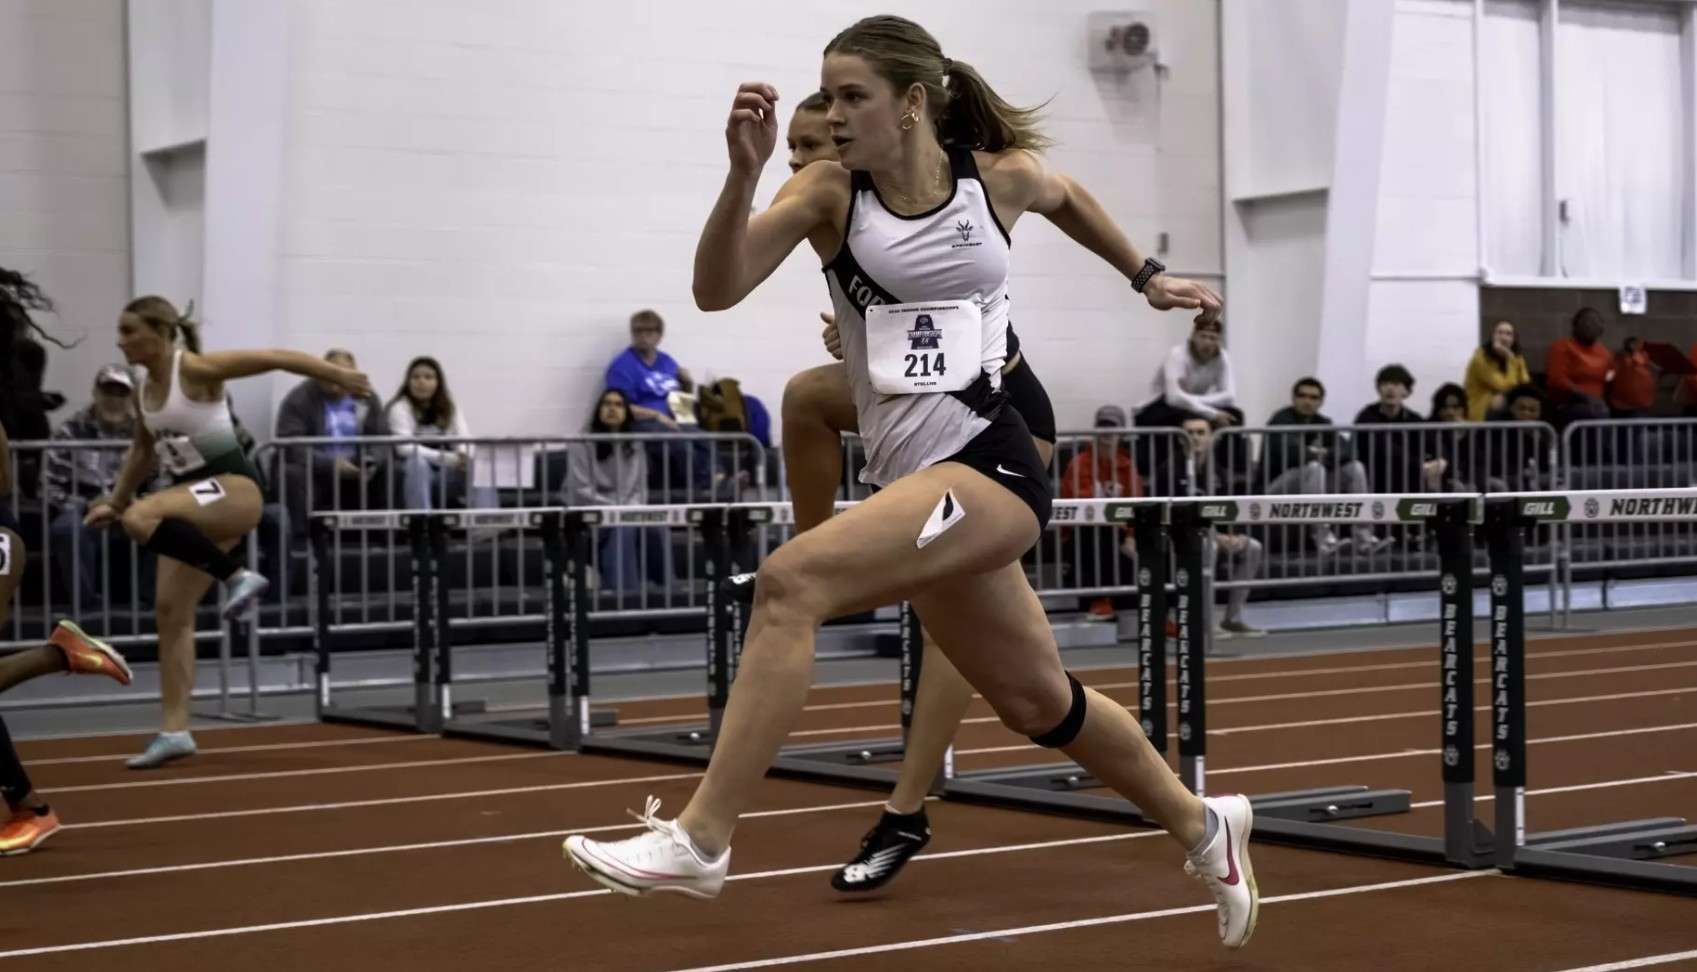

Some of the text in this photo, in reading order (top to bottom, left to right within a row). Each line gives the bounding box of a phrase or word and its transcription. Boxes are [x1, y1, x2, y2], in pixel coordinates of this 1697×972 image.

[904, 352, 946, 377] 214
[195, 481, 221, 495] 7
[1269, 502, 1364, 519] NORTHWEST
[1523, 502, 1555, 516] GILL
[1443, 603, 1459, 736] BEARCATS
[1495, 605, 1510, 739] BEARCATS
